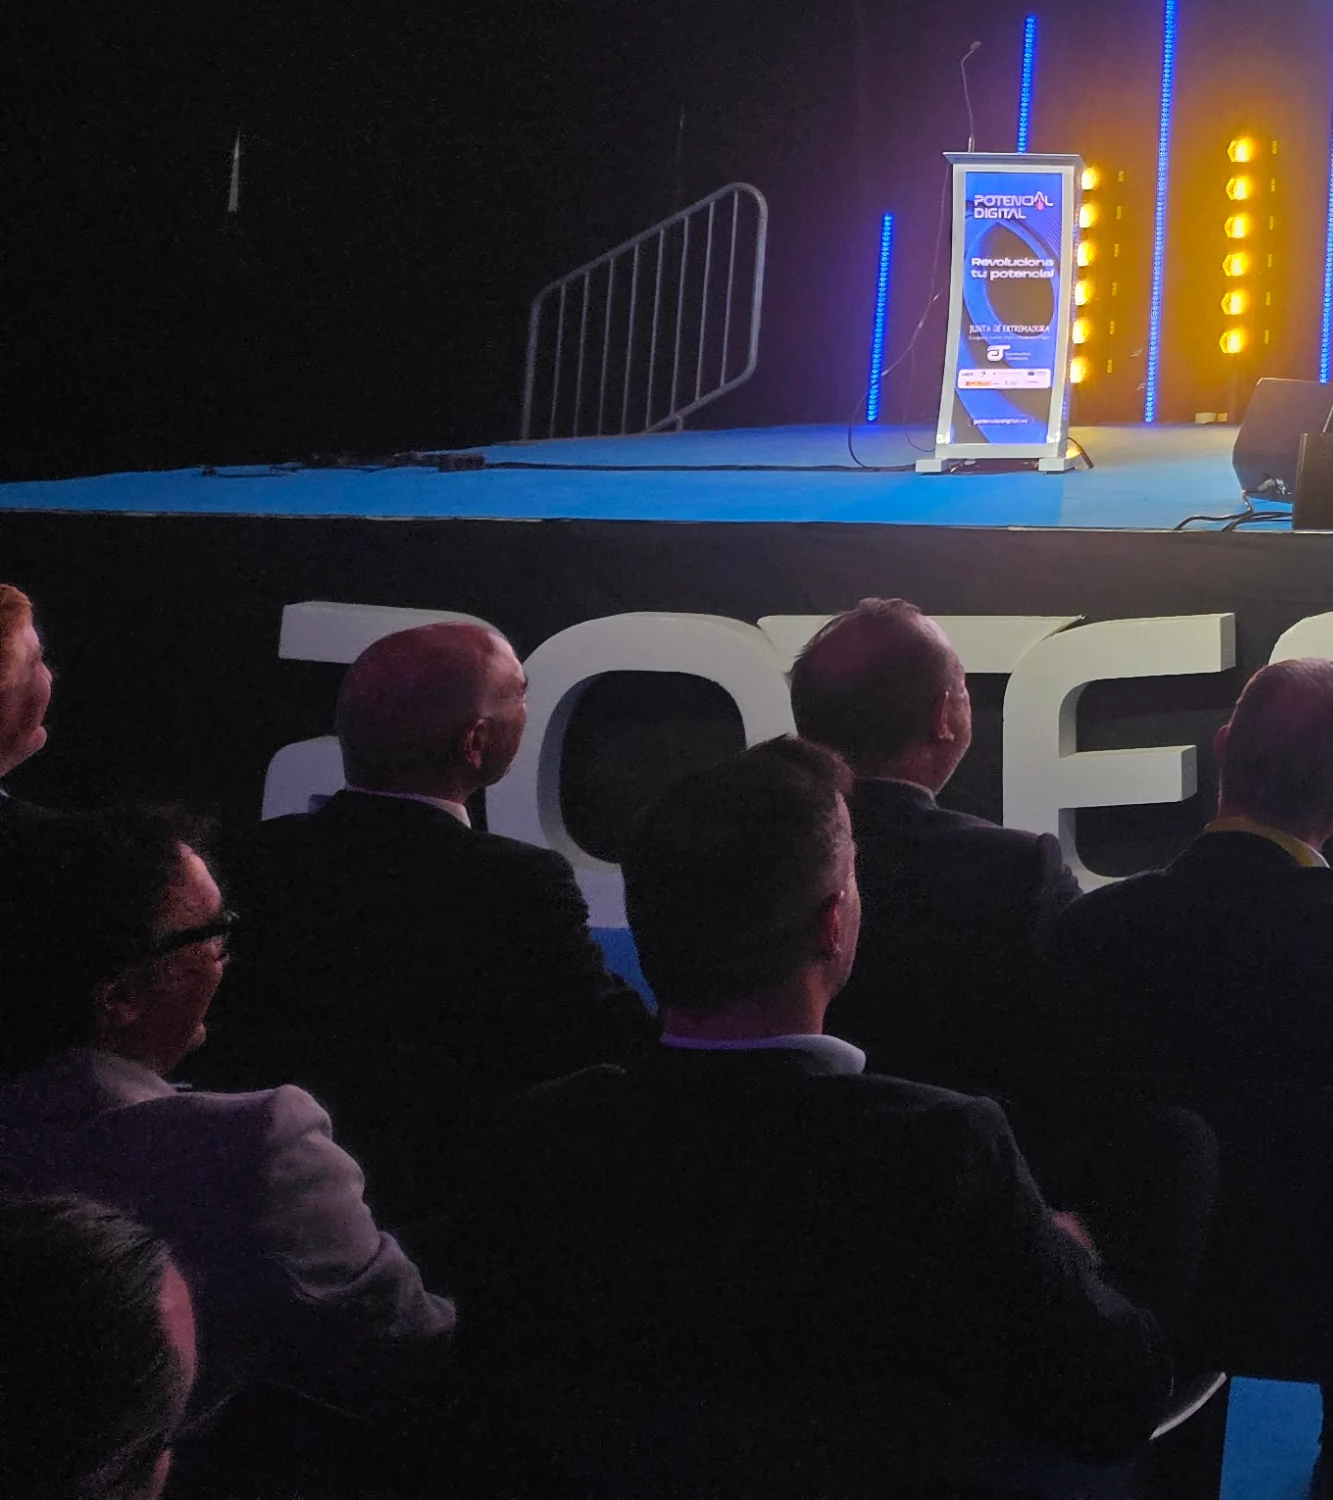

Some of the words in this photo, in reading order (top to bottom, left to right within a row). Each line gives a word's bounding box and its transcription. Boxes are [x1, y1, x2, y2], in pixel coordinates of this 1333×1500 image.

[974, 191, 1055, 210] POTENCIAL
[974, 207, 1027, 219] DIGITAL
[971, 257, 1054, 267] Revoluciona
[971, 269, 987, 278] tu
[990, 269, 1055, 281] potencial
